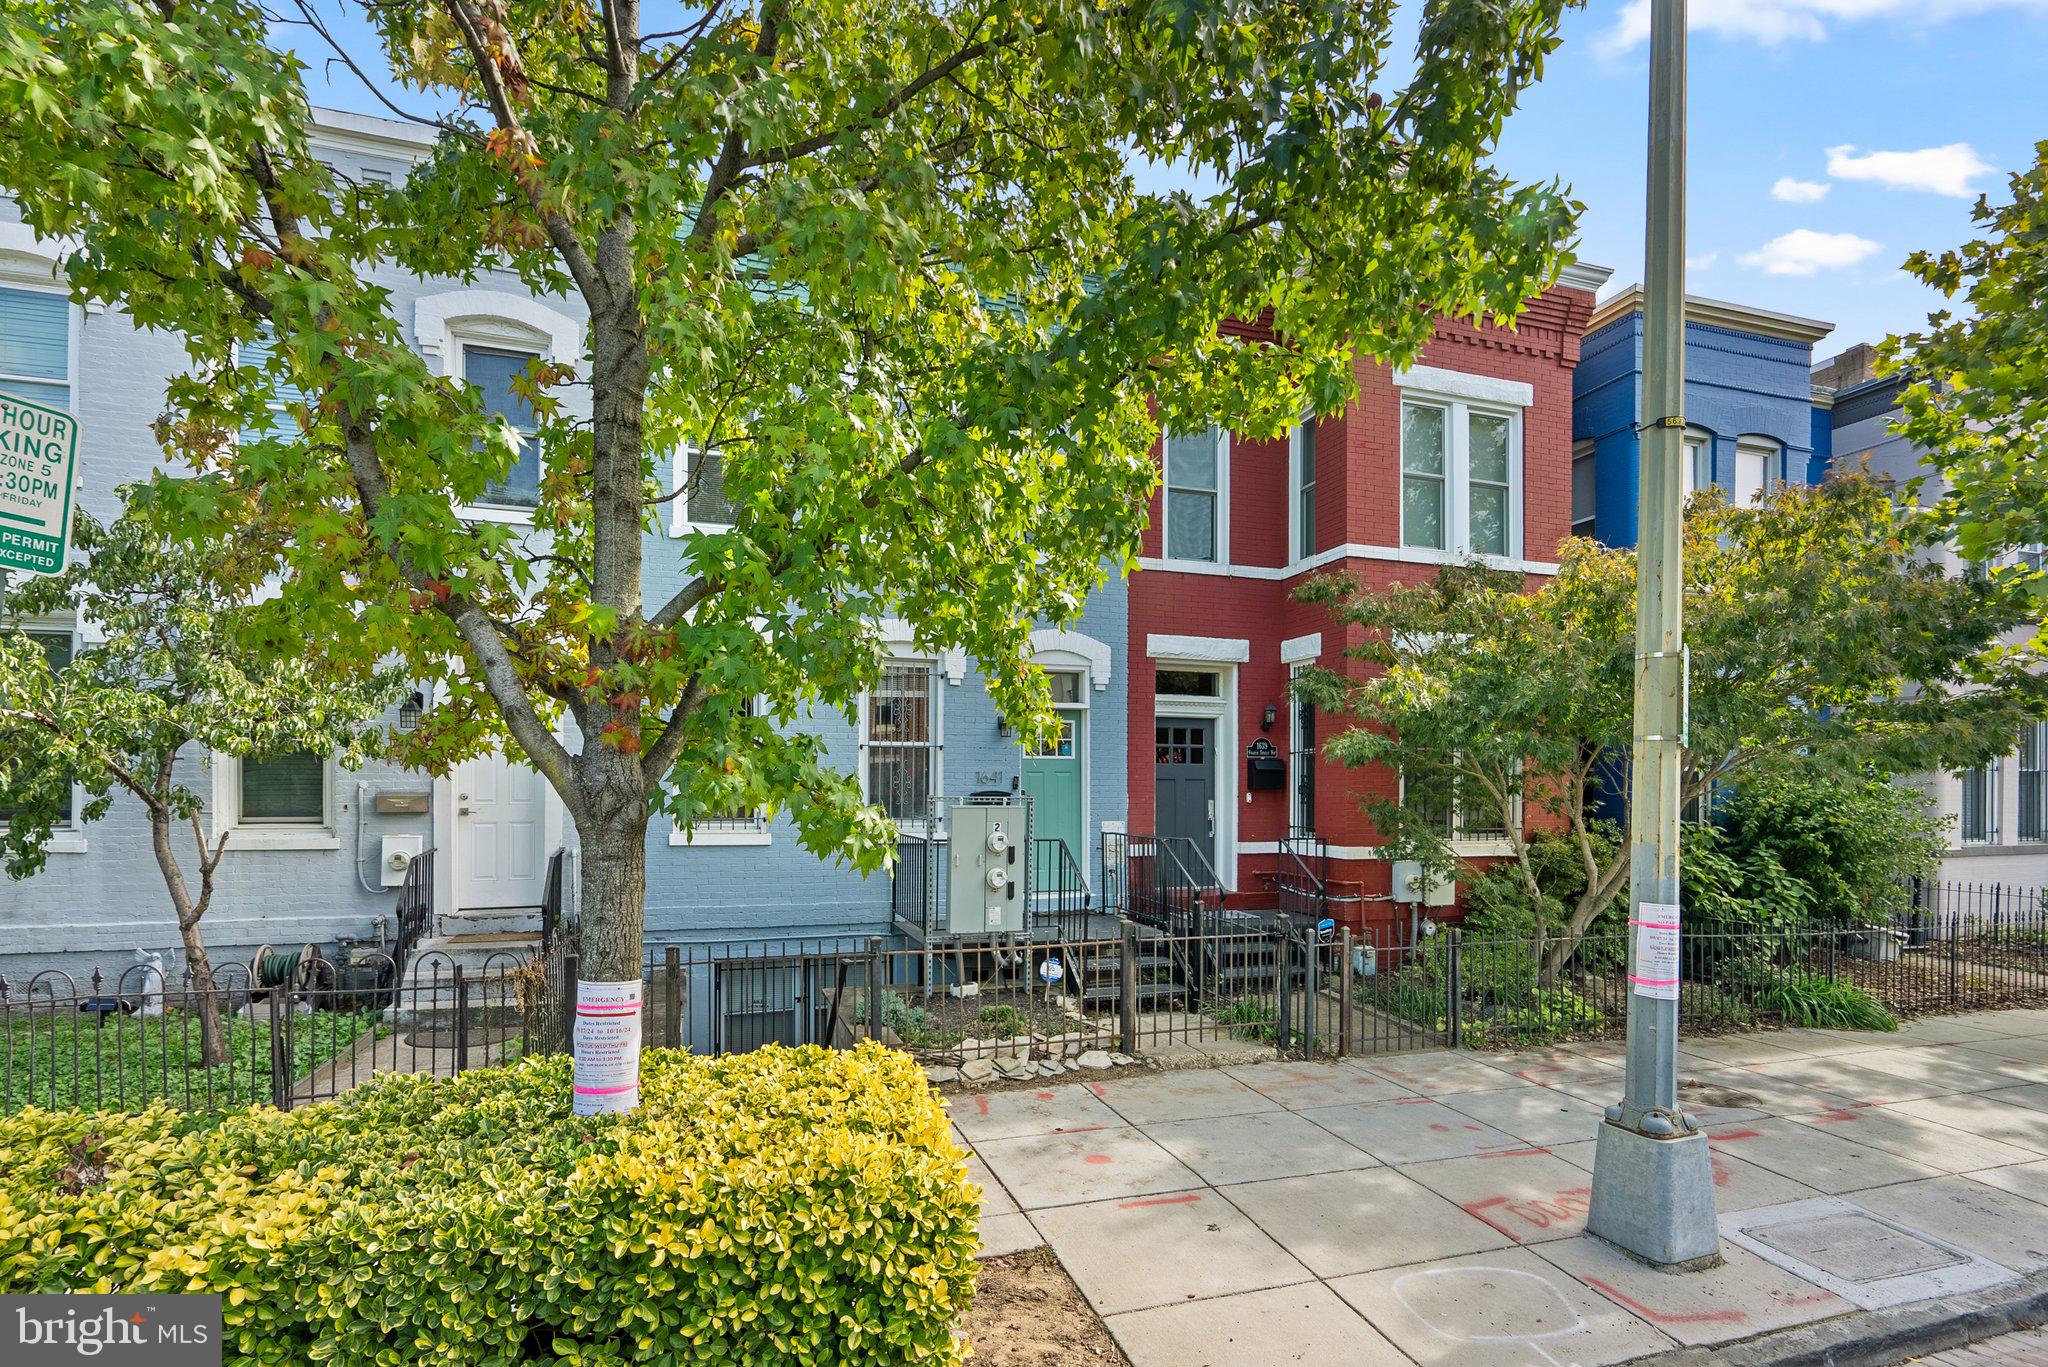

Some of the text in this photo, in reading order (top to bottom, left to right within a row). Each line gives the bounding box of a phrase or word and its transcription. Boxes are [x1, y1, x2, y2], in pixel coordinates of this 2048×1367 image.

[3, 406, 67, 440] HOUR
[0, 453, 52, 476] ZONE 5
[2, 532, 59, 553] PERMIT
[976, 771, 1003, 784] 1641
[995, 822, 1001, 832] 2
